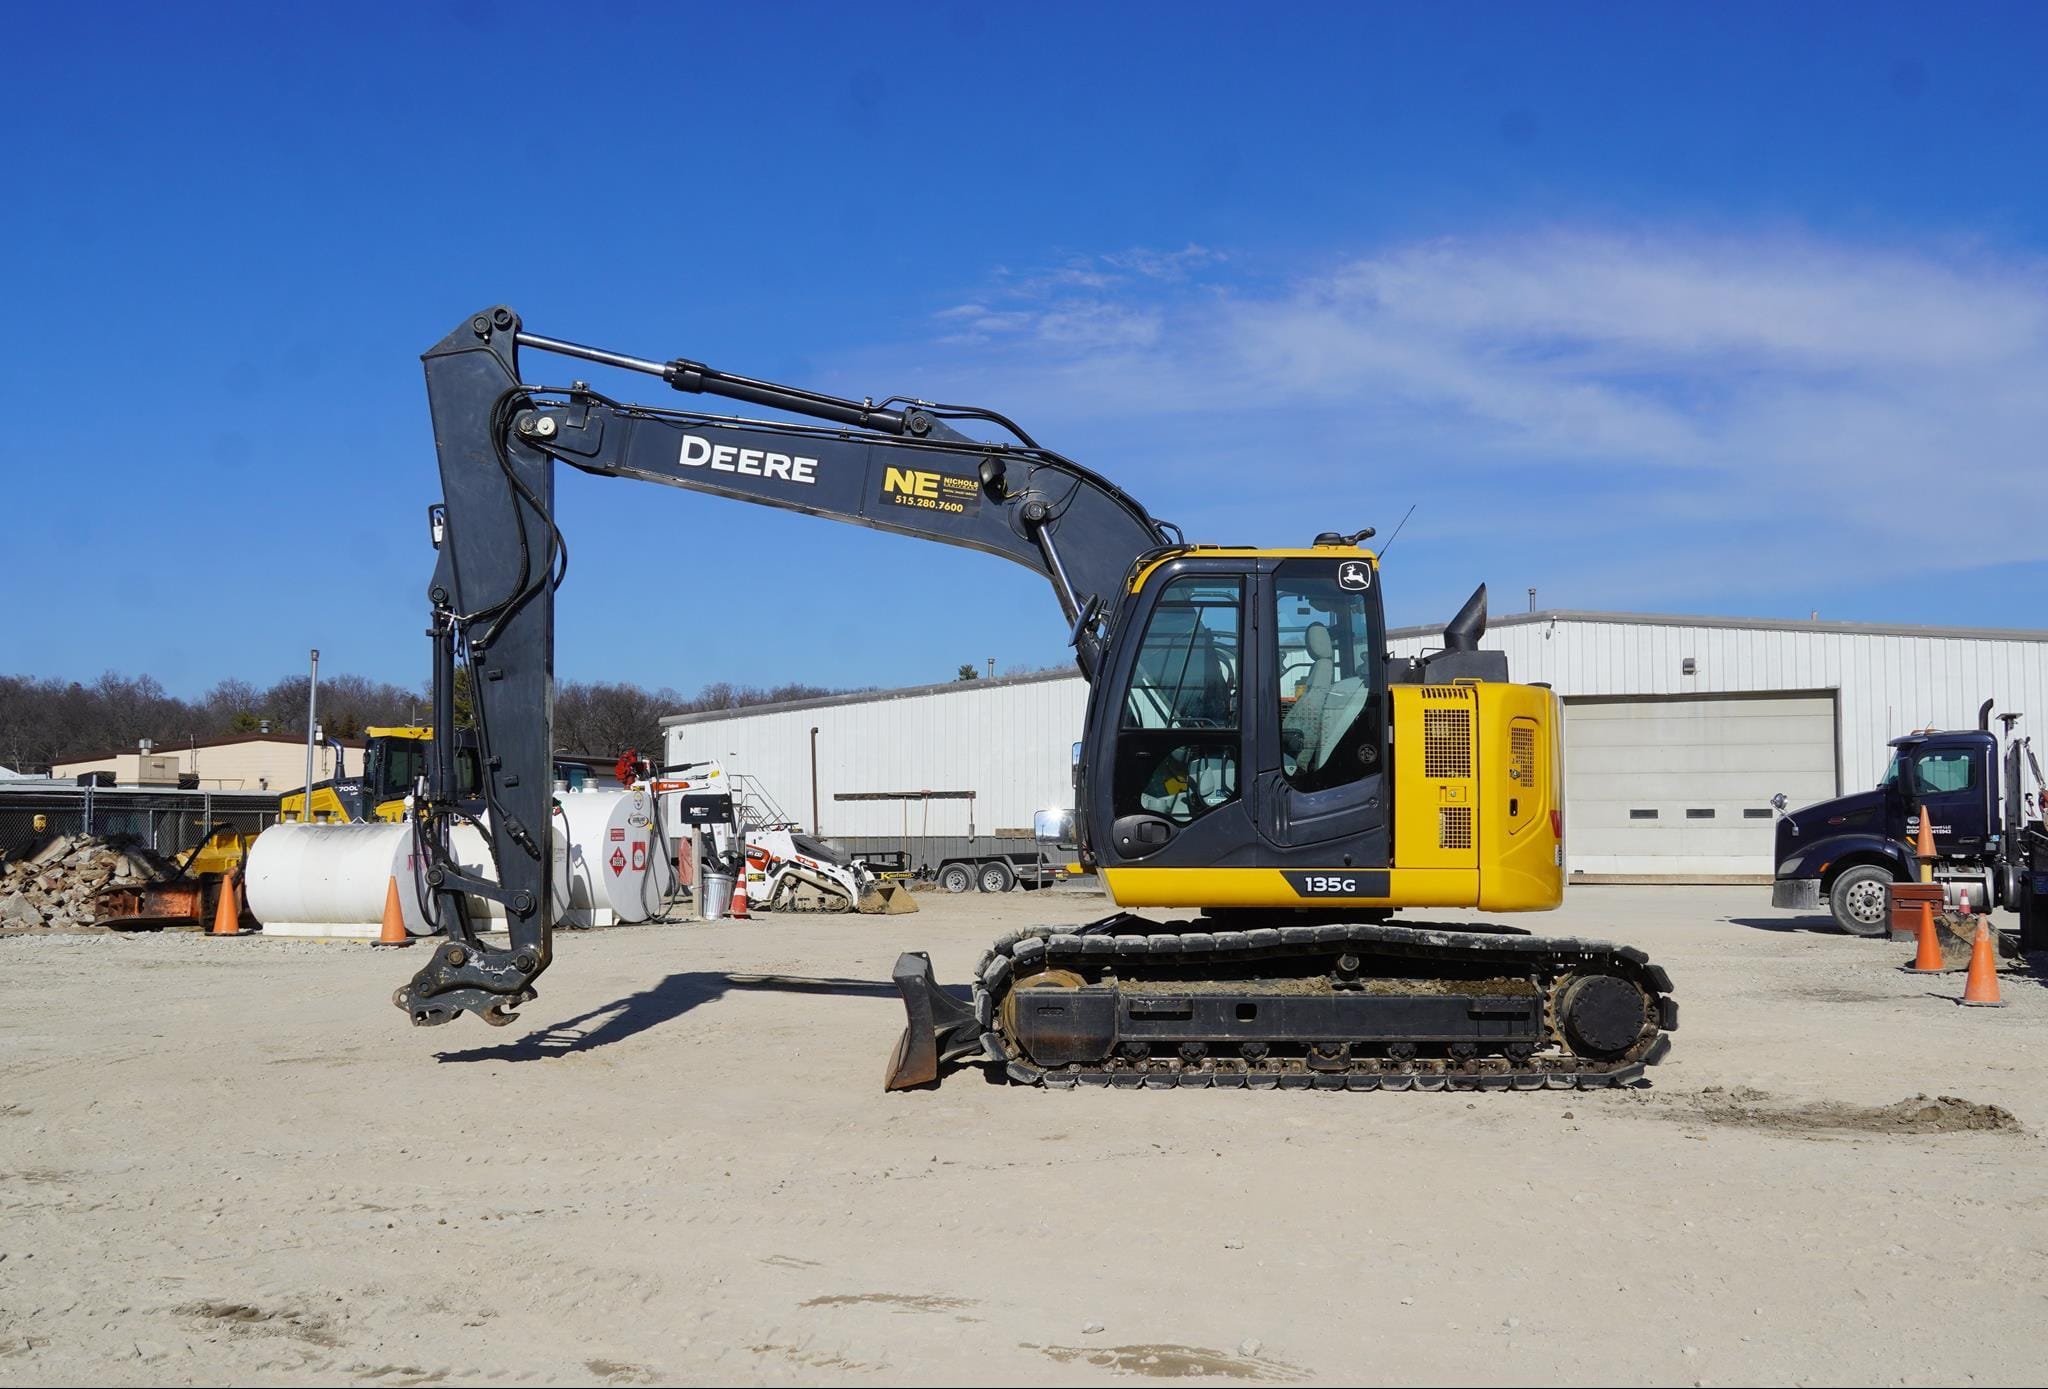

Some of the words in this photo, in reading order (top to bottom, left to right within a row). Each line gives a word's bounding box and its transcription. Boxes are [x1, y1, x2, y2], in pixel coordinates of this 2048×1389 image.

[679, 434, 818, 484] DEERE
[884, 467, 941, 499] NE
[944, 477, 979, 488] NICHOLS
[895, 495, 963, 513] 515.280.7600
[1305, 877, 1356, 892] 135G
